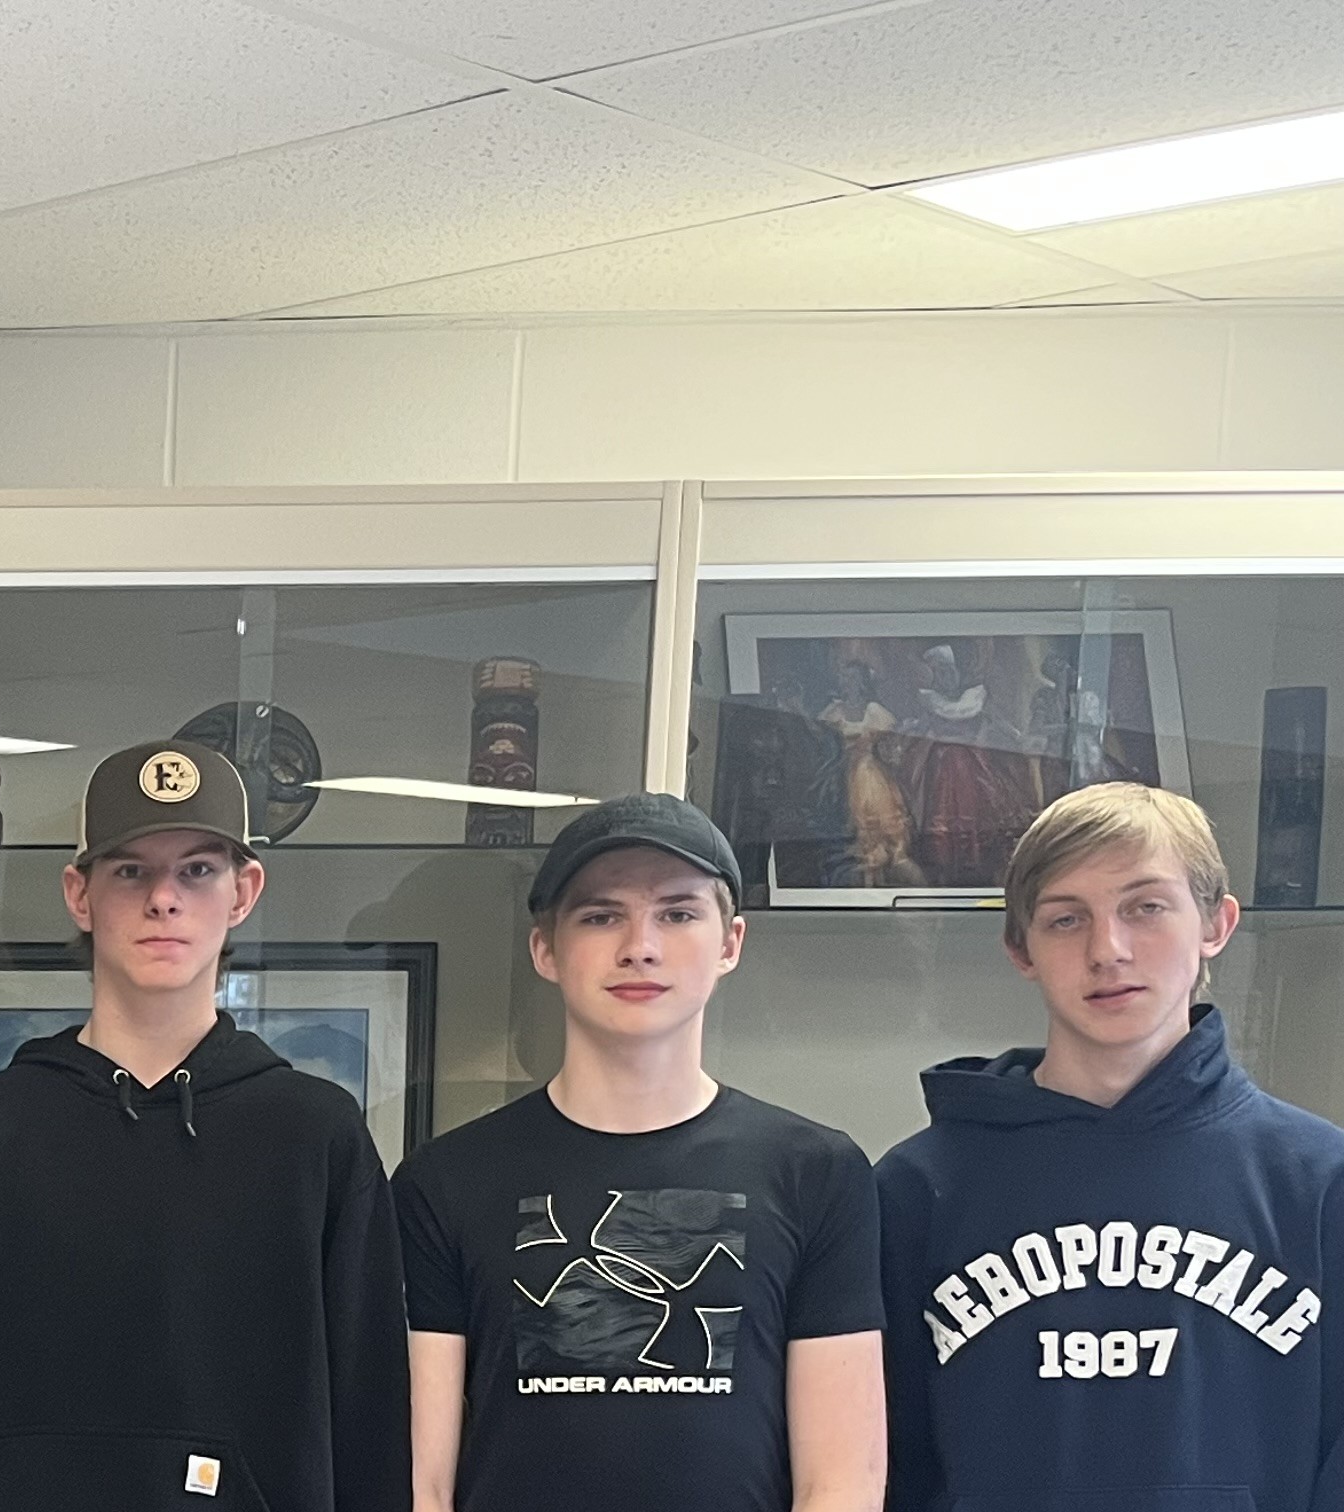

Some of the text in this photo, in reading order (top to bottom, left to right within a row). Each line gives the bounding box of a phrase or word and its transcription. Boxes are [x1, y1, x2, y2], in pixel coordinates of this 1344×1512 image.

[923, 1221, 1322, 1365] AEROPOSTALE
[1038, 1328, 1179, 1379] 1987
[518, 1376, 732, 1394] UNDER ARMOUR
